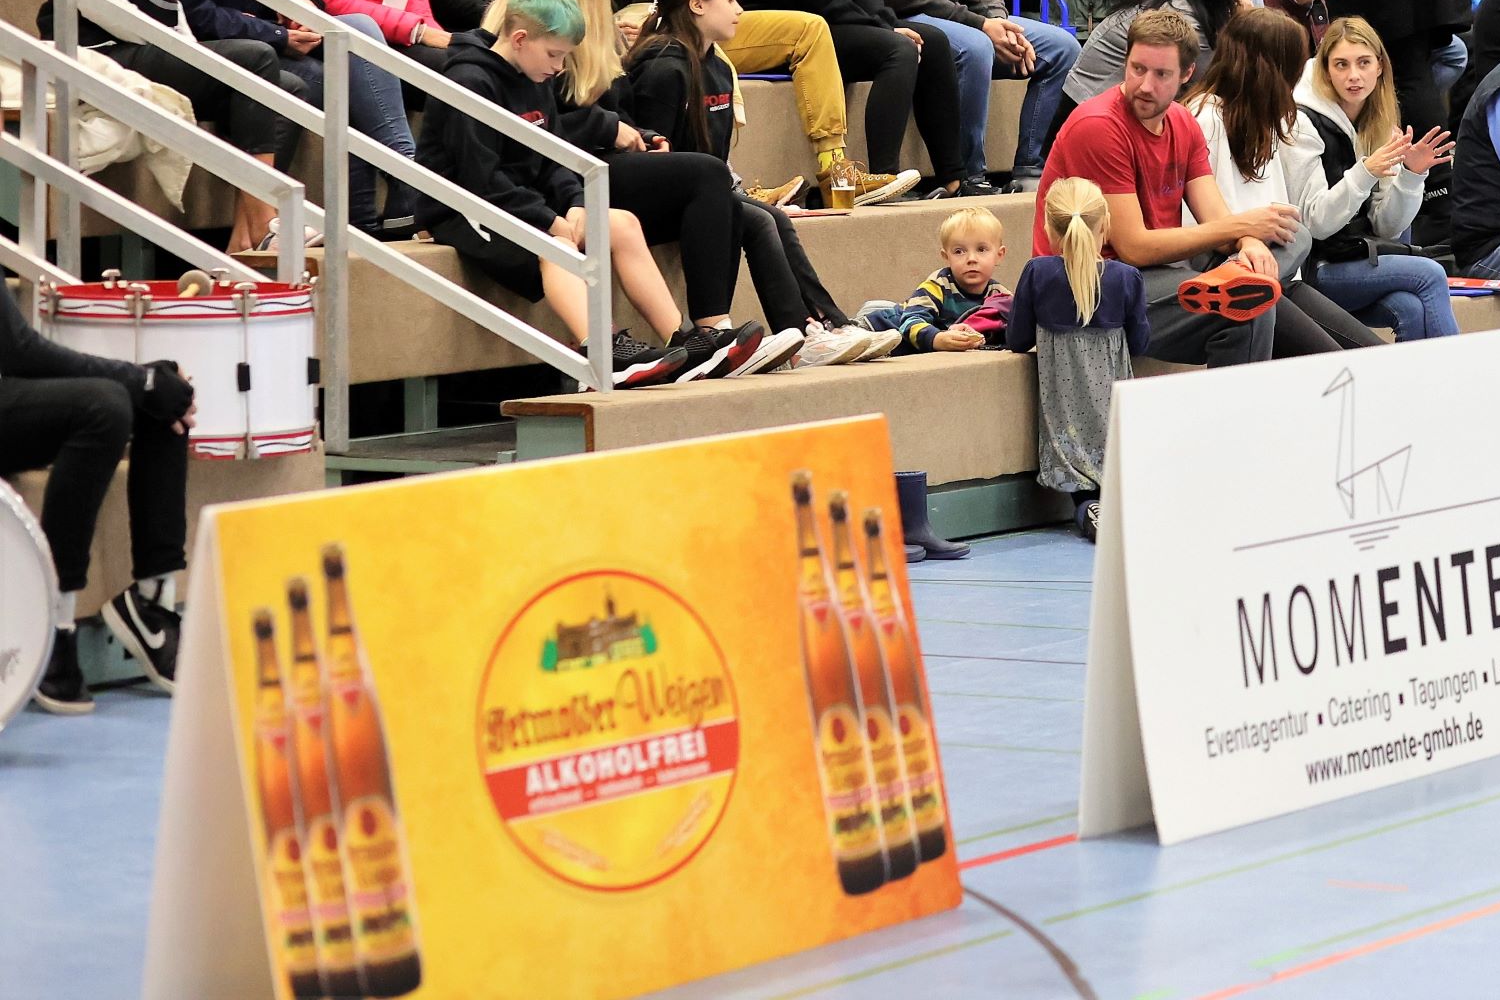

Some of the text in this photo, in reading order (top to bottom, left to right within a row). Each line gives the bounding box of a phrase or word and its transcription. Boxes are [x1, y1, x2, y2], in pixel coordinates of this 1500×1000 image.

[1204, 710, 1310, 759] Eventagentur
[1327, 689, 1392, 728] Catering
[1408, 669, 1477, 711] Tagungen
[1305, 713, 1484, 786] www.momente-gmbh.de
[525, 730, 708, 797] ALKOHOLFREI
